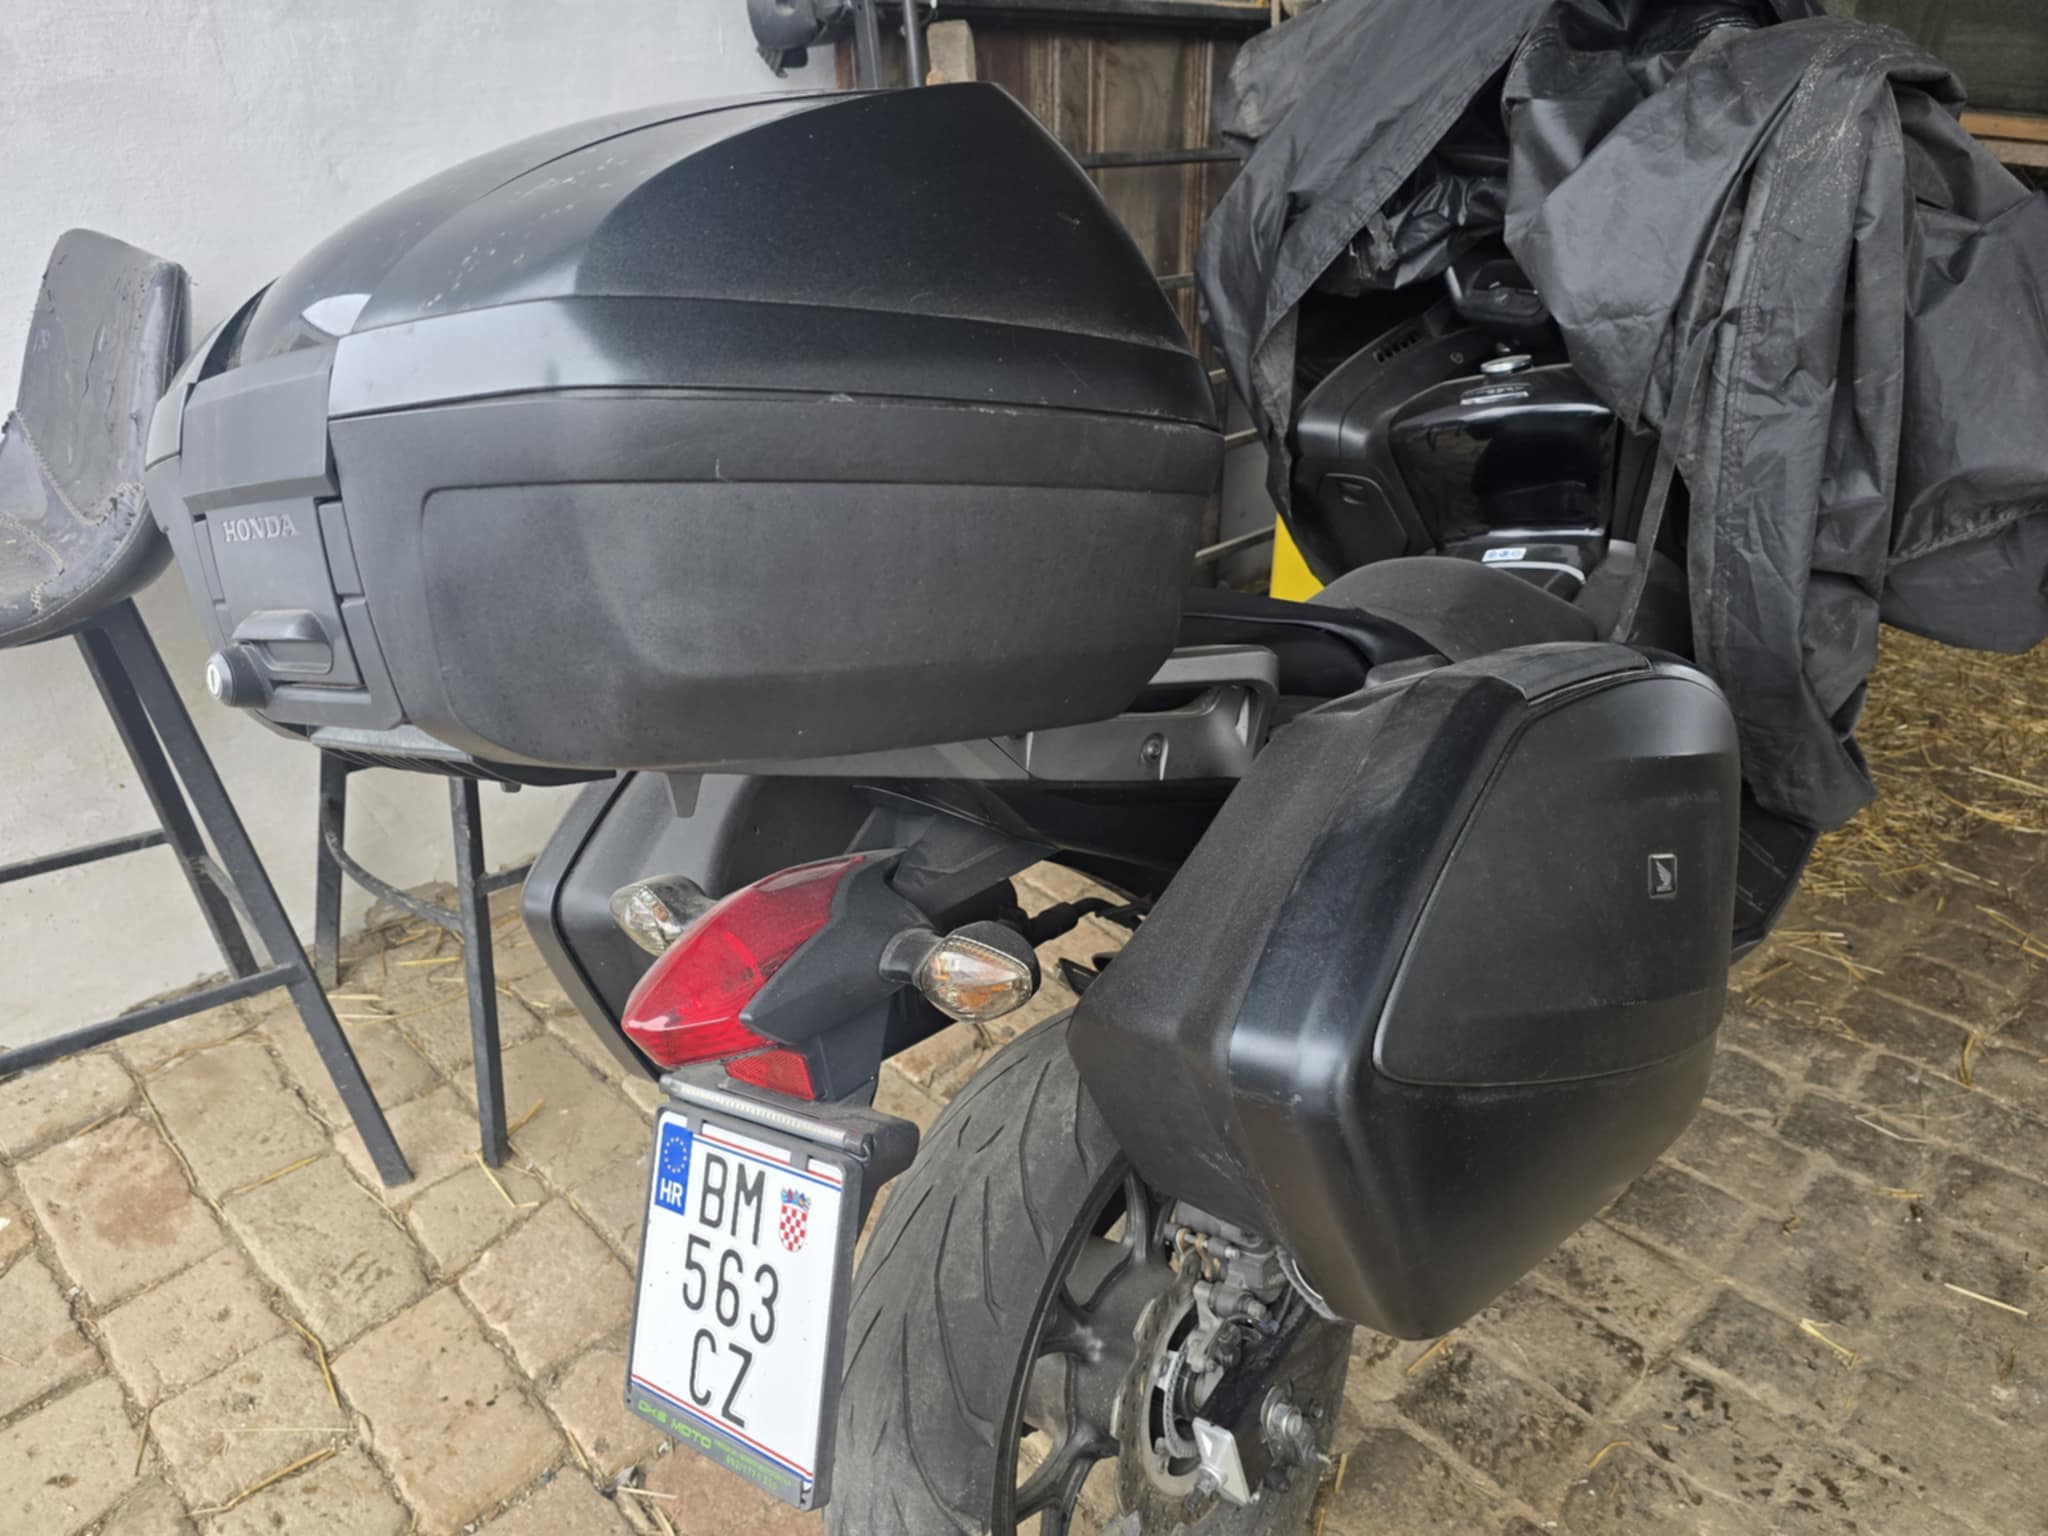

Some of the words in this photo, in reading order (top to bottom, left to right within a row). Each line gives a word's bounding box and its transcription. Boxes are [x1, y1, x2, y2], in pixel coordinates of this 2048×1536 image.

[223, 514, 297, 542] HONDA
[659, 1178, 684, 1208] HR
[699, 1152, 766, 1246] BM
[682, 1234, 779, 1344] 563
[688, 1329, 753, 1429] CZ
[671, 1418, 712, 1450] MOTO
